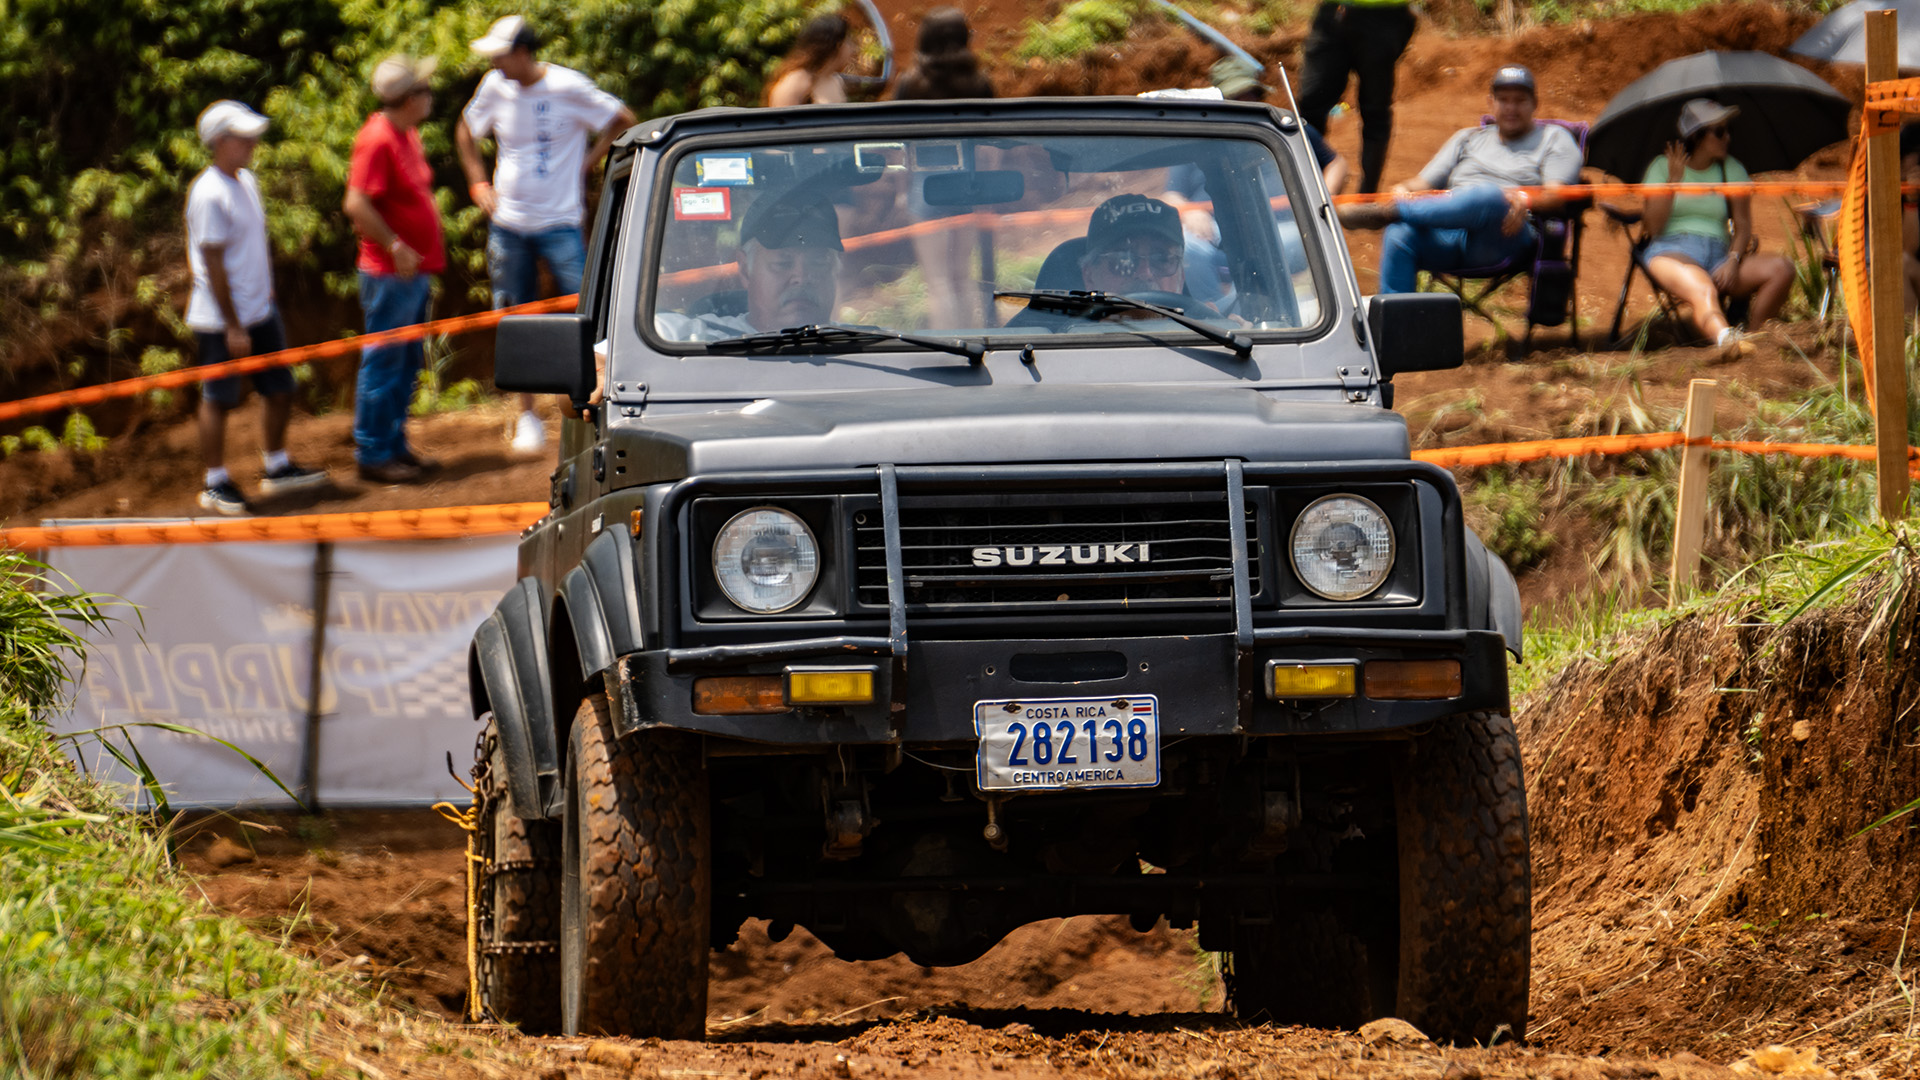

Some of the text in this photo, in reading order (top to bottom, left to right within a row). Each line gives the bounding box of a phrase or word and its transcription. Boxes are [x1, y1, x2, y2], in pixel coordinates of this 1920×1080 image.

[972, 543, 1150, 567] SUZUKI
[1026, 706, 1107, 719] COSTA RICA
[1007, 718, 1148, 766] 282138
[1013, 769, 1124, 784] CENTROAMERICA
